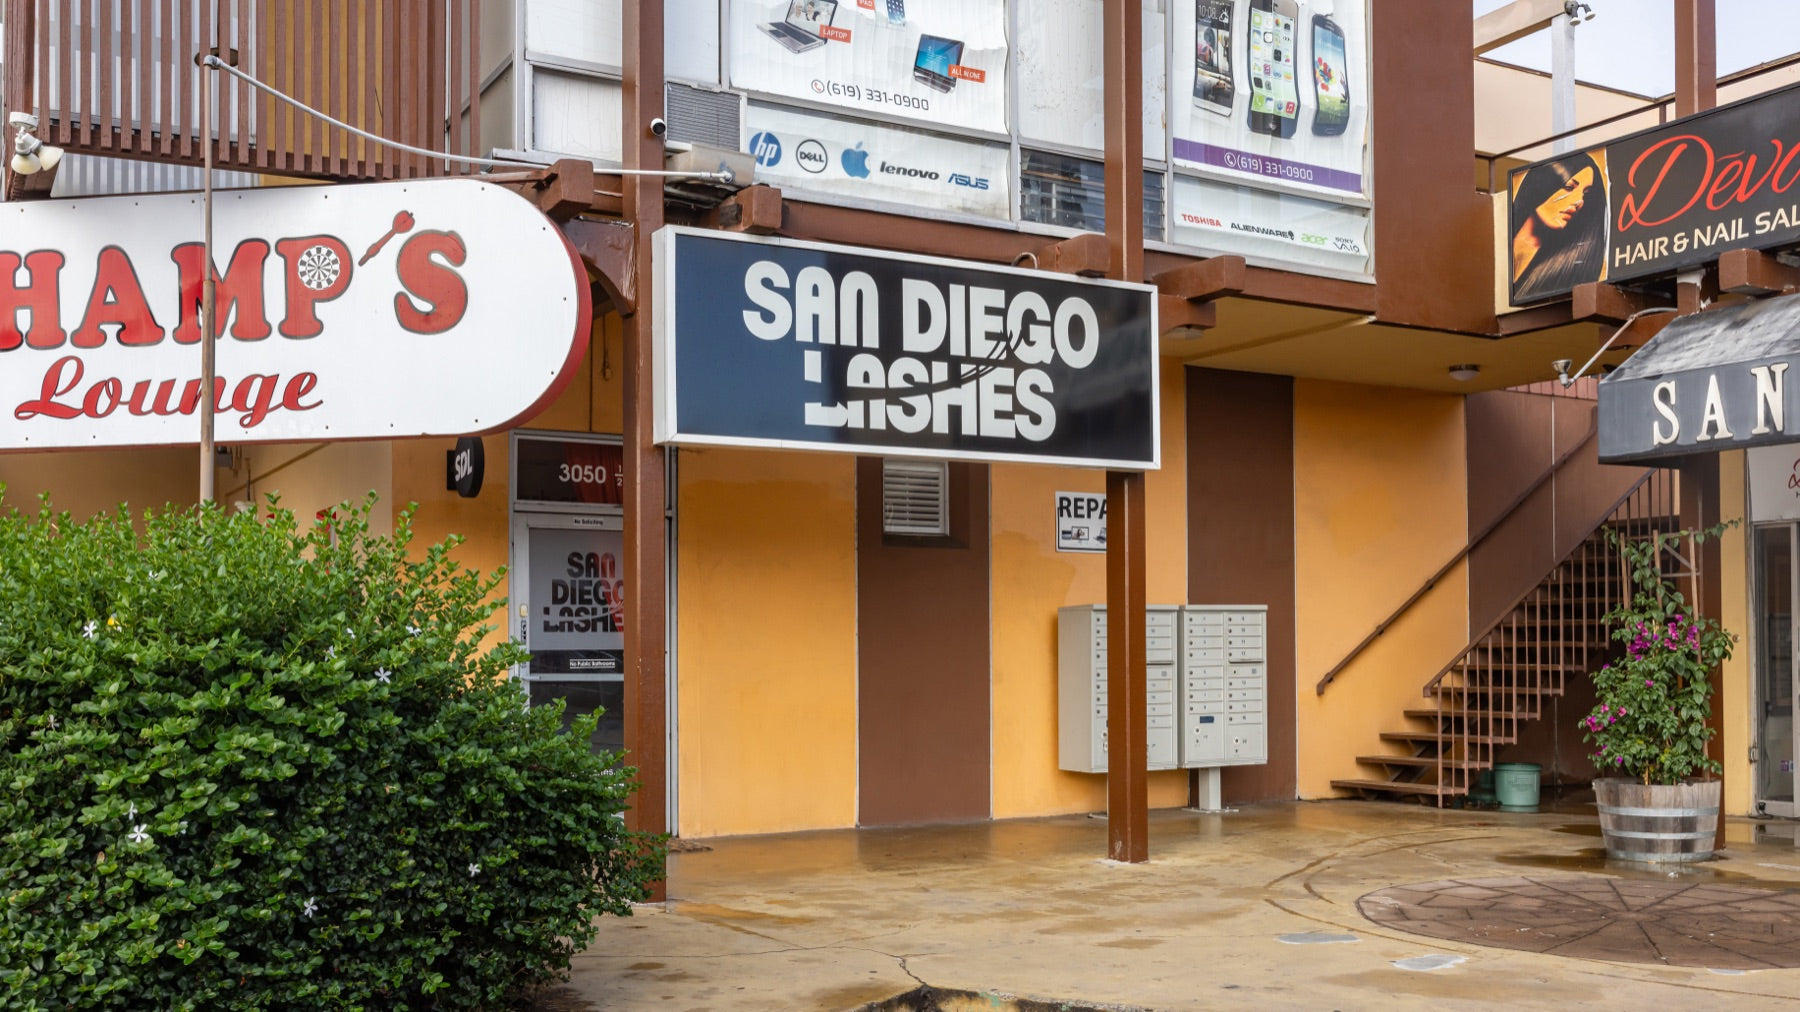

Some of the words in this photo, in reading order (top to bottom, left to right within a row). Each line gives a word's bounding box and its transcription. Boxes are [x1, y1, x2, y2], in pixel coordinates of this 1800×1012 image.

[822, 29, 848, 39] LAPTOP
[951, 67, 962, 76] ALL
[970, 71, 982, 79] ONE
[826, 80, 861, 100] (619)
[866, 88, 929, 111] 331-0900
[754, 131, 779, 167] hp
[800, 151, 824, 163] DELL
[880, 161, 940, 181] lenovo
[1237, 154, 1263, 173] (619)
[1265, 161, 1313, 180] 331-0900
[947, 173, 989, 190] ASUS
[1181, 213, 1222, 227] TOSHIBA
[1230, 222, 1289, 239] ALIENWARE
[1301, 233, 1328, 246] acer
[1614, 236, 1669, 268] HAIR
[1673, 232, 1690, 253] &
[1693, 217, 1749, 249] NAIL
[743, 260, 879, 349] SAN
[902, 278, 1099, 369] DIEGO
[14, 355, 324, 429] Lounge
[804, 350, 1057, 442] LASHES
[455, 448, 473, 482] SDL
[558, 463, 606, 484] 3050
[566, 551, 616, 578] SAN
[543, 606, 624, 633] LASHE
